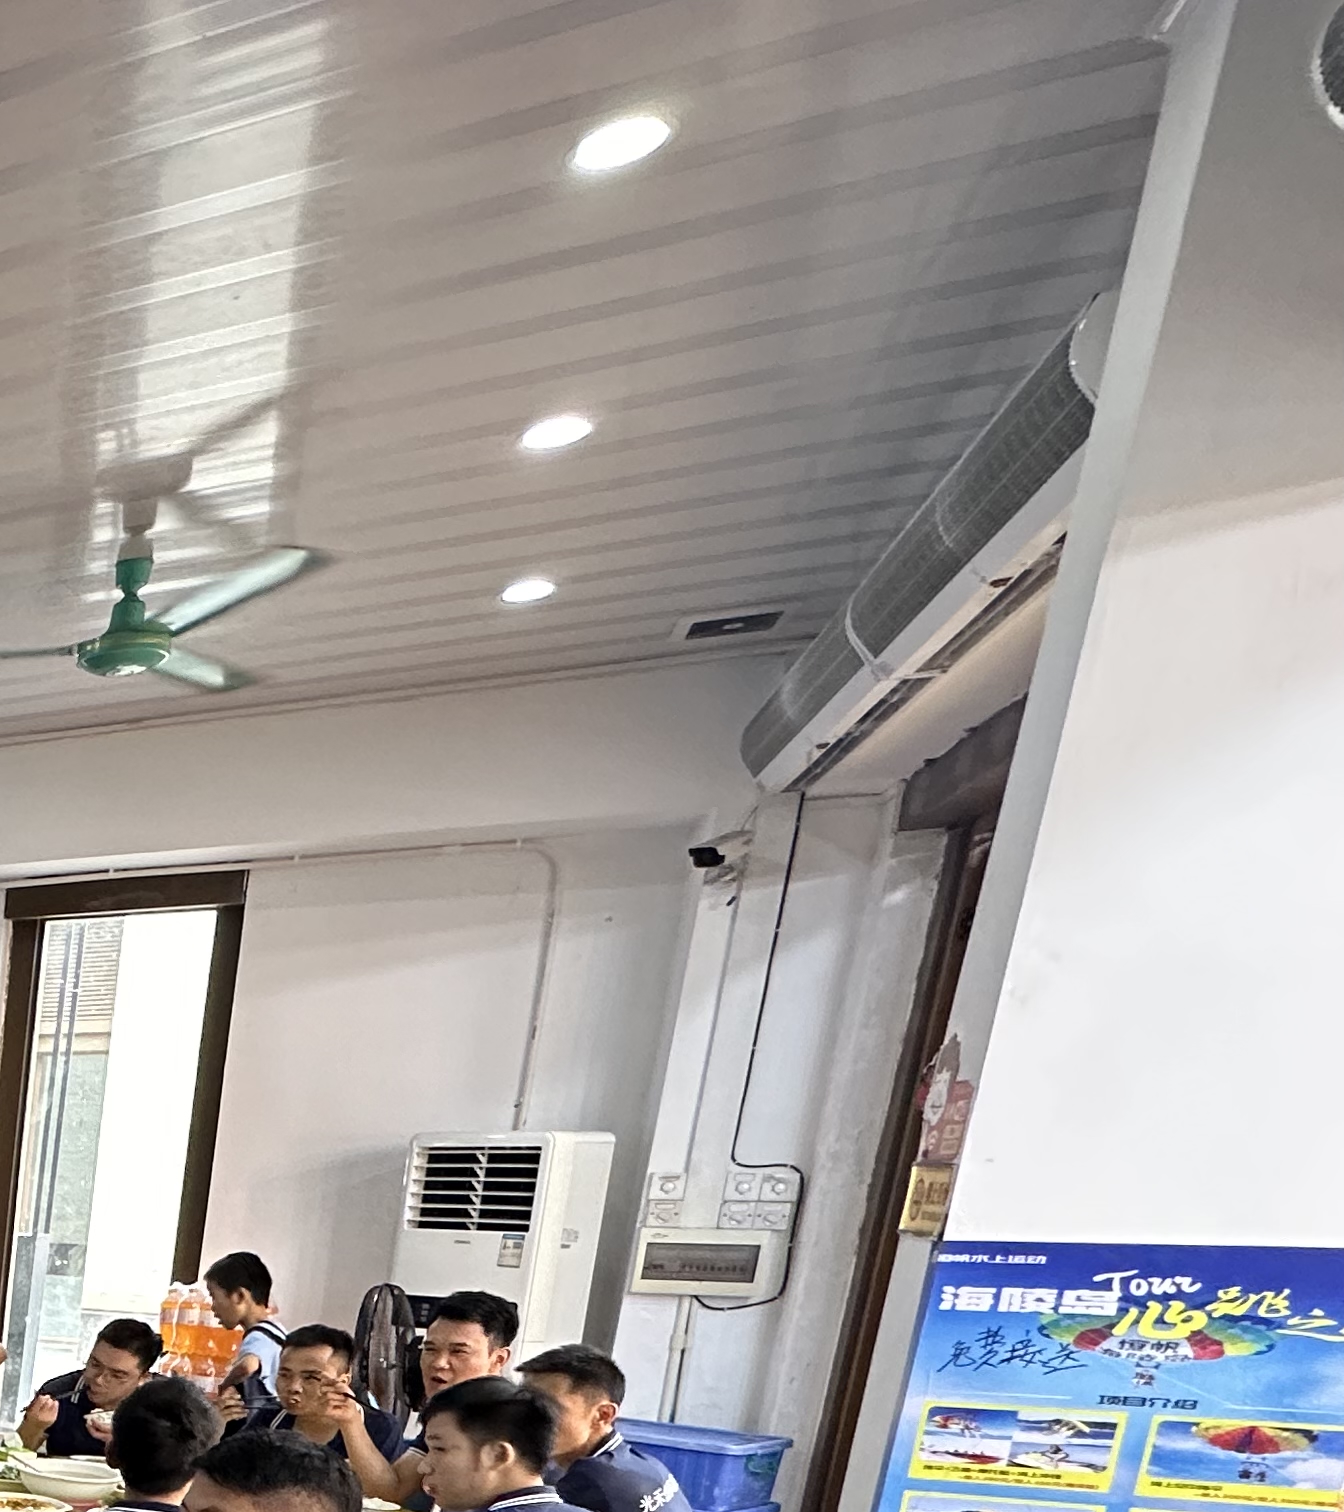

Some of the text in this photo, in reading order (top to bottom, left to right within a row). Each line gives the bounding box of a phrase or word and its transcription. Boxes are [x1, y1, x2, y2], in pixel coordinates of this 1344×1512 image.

[1092, 1269, 1202, 1296] Tour
[938, 1285, 1119, 1316] 海陵岛
[936, 1324, 1089, 1376] 免费接送
[1097, 1394, 1199, 1411] 项目介绍
